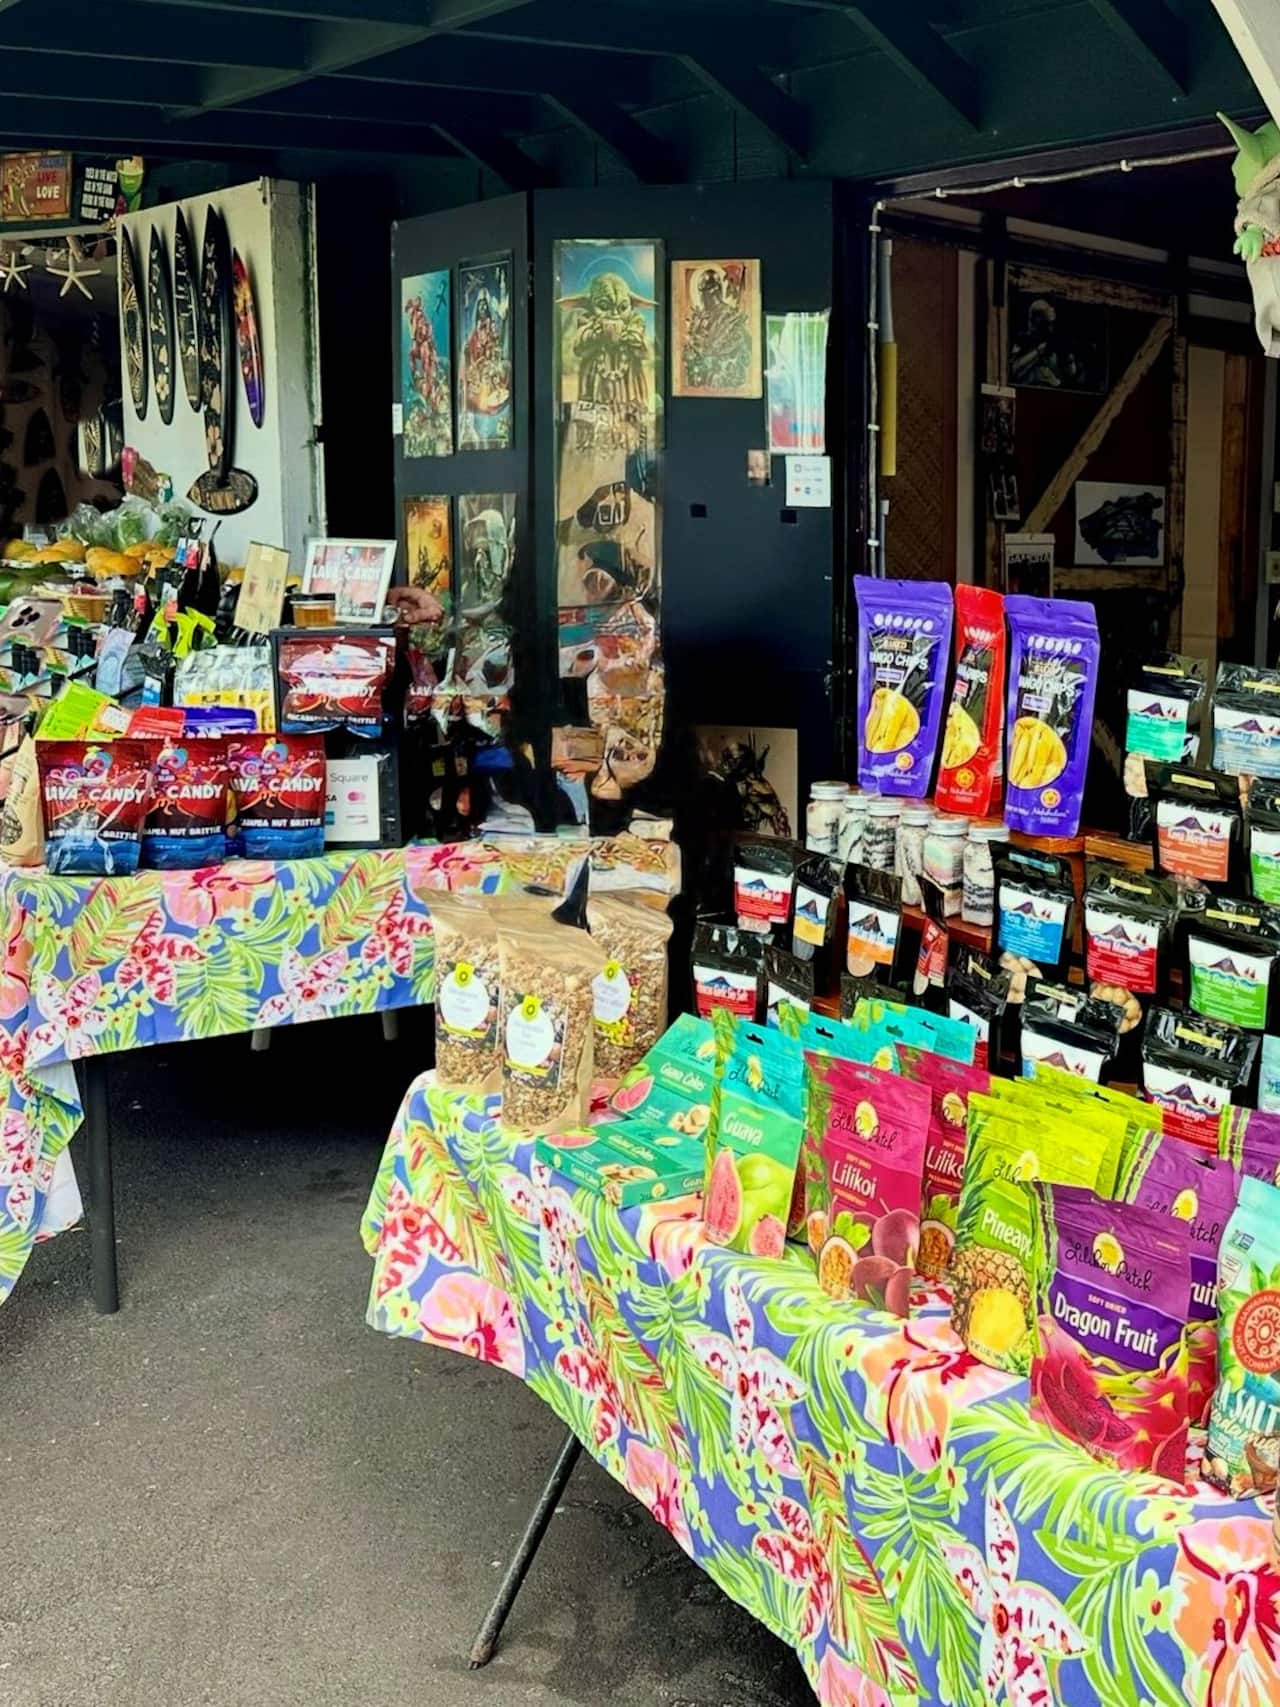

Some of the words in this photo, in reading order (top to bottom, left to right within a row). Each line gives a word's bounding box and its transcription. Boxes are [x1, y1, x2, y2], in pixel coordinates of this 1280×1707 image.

[36, 185, 60, 199] LOVE
[166, 784, 224, 800] CANDY
[269, 776, 323, 792] CANDY
[330, 772, 369, 784] Square
[89, 788, 146, 804] CANDY
[1153, 1094, 1174, 1112] Kona
[1175, 1103, 1207, 1123] Mango
[723, 1112, 764, 1147] Guava
[832, 1160, 878, 1200] Lilikoi
[1116, 1259, 1153, 1293] Patch
[1191, 1281, 1219, 1309] ruit
[1054, 1292, 1112, 1340] Dragon
[1114, 1318, 1160, 1358] Fruit
